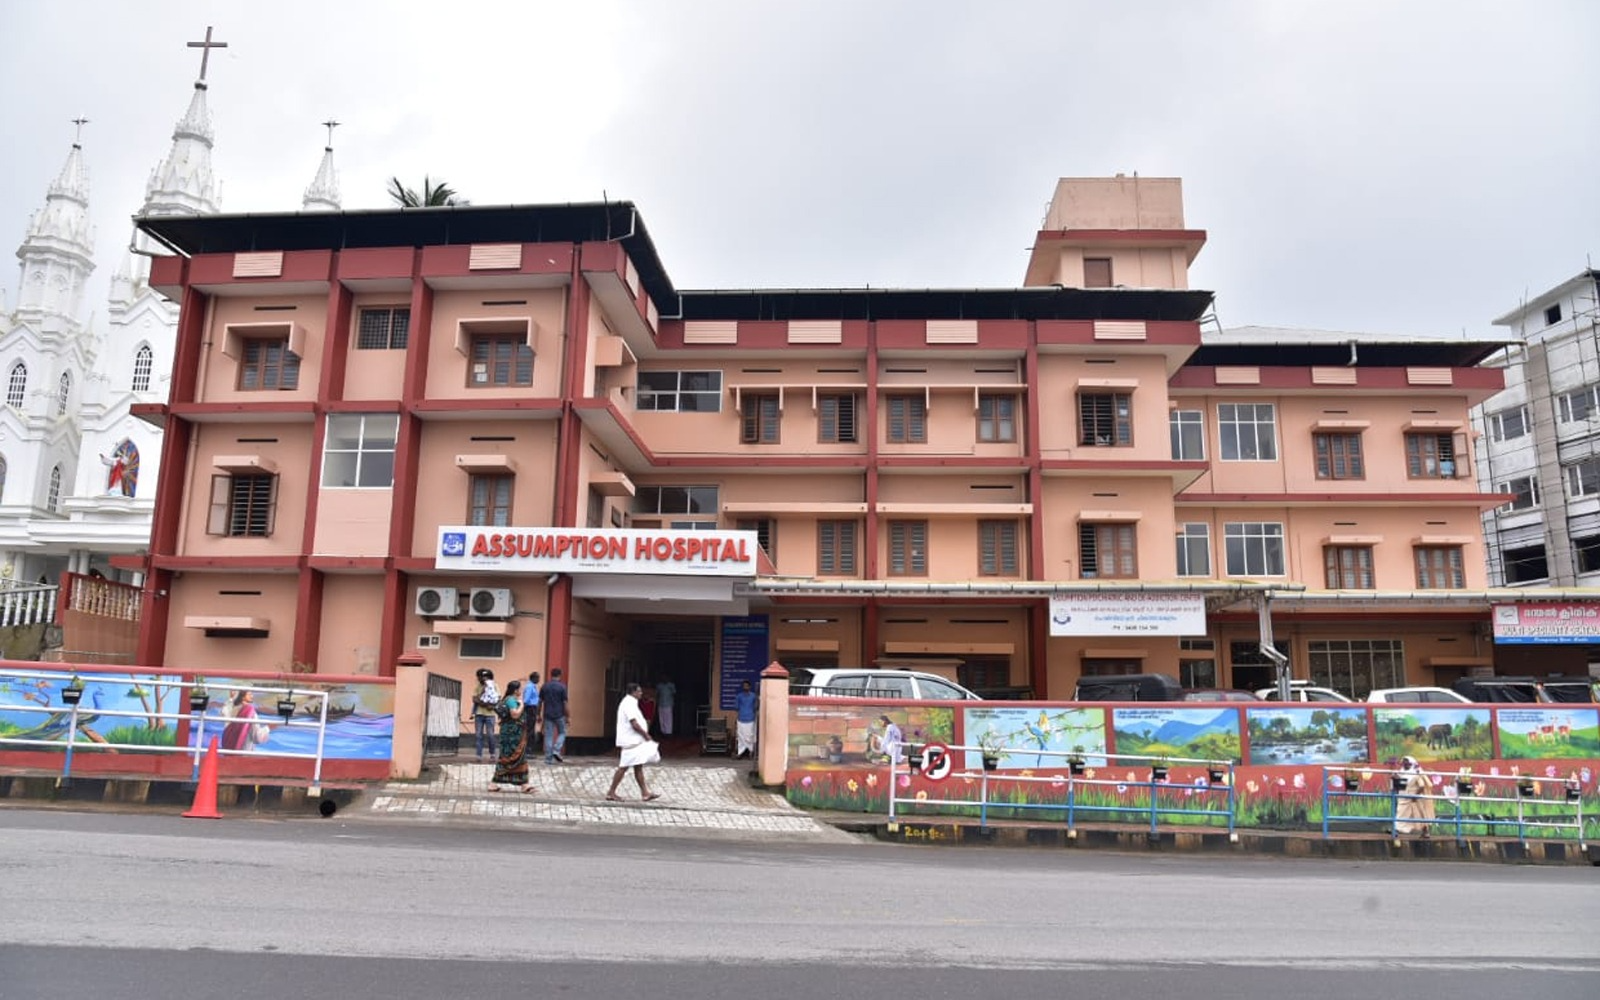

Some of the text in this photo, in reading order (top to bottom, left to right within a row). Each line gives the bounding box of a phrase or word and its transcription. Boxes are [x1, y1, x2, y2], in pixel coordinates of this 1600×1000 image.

[472, 534, 750, 562] ASSUMPTION HOSPITAL
[928, 749, 946, 775] P
